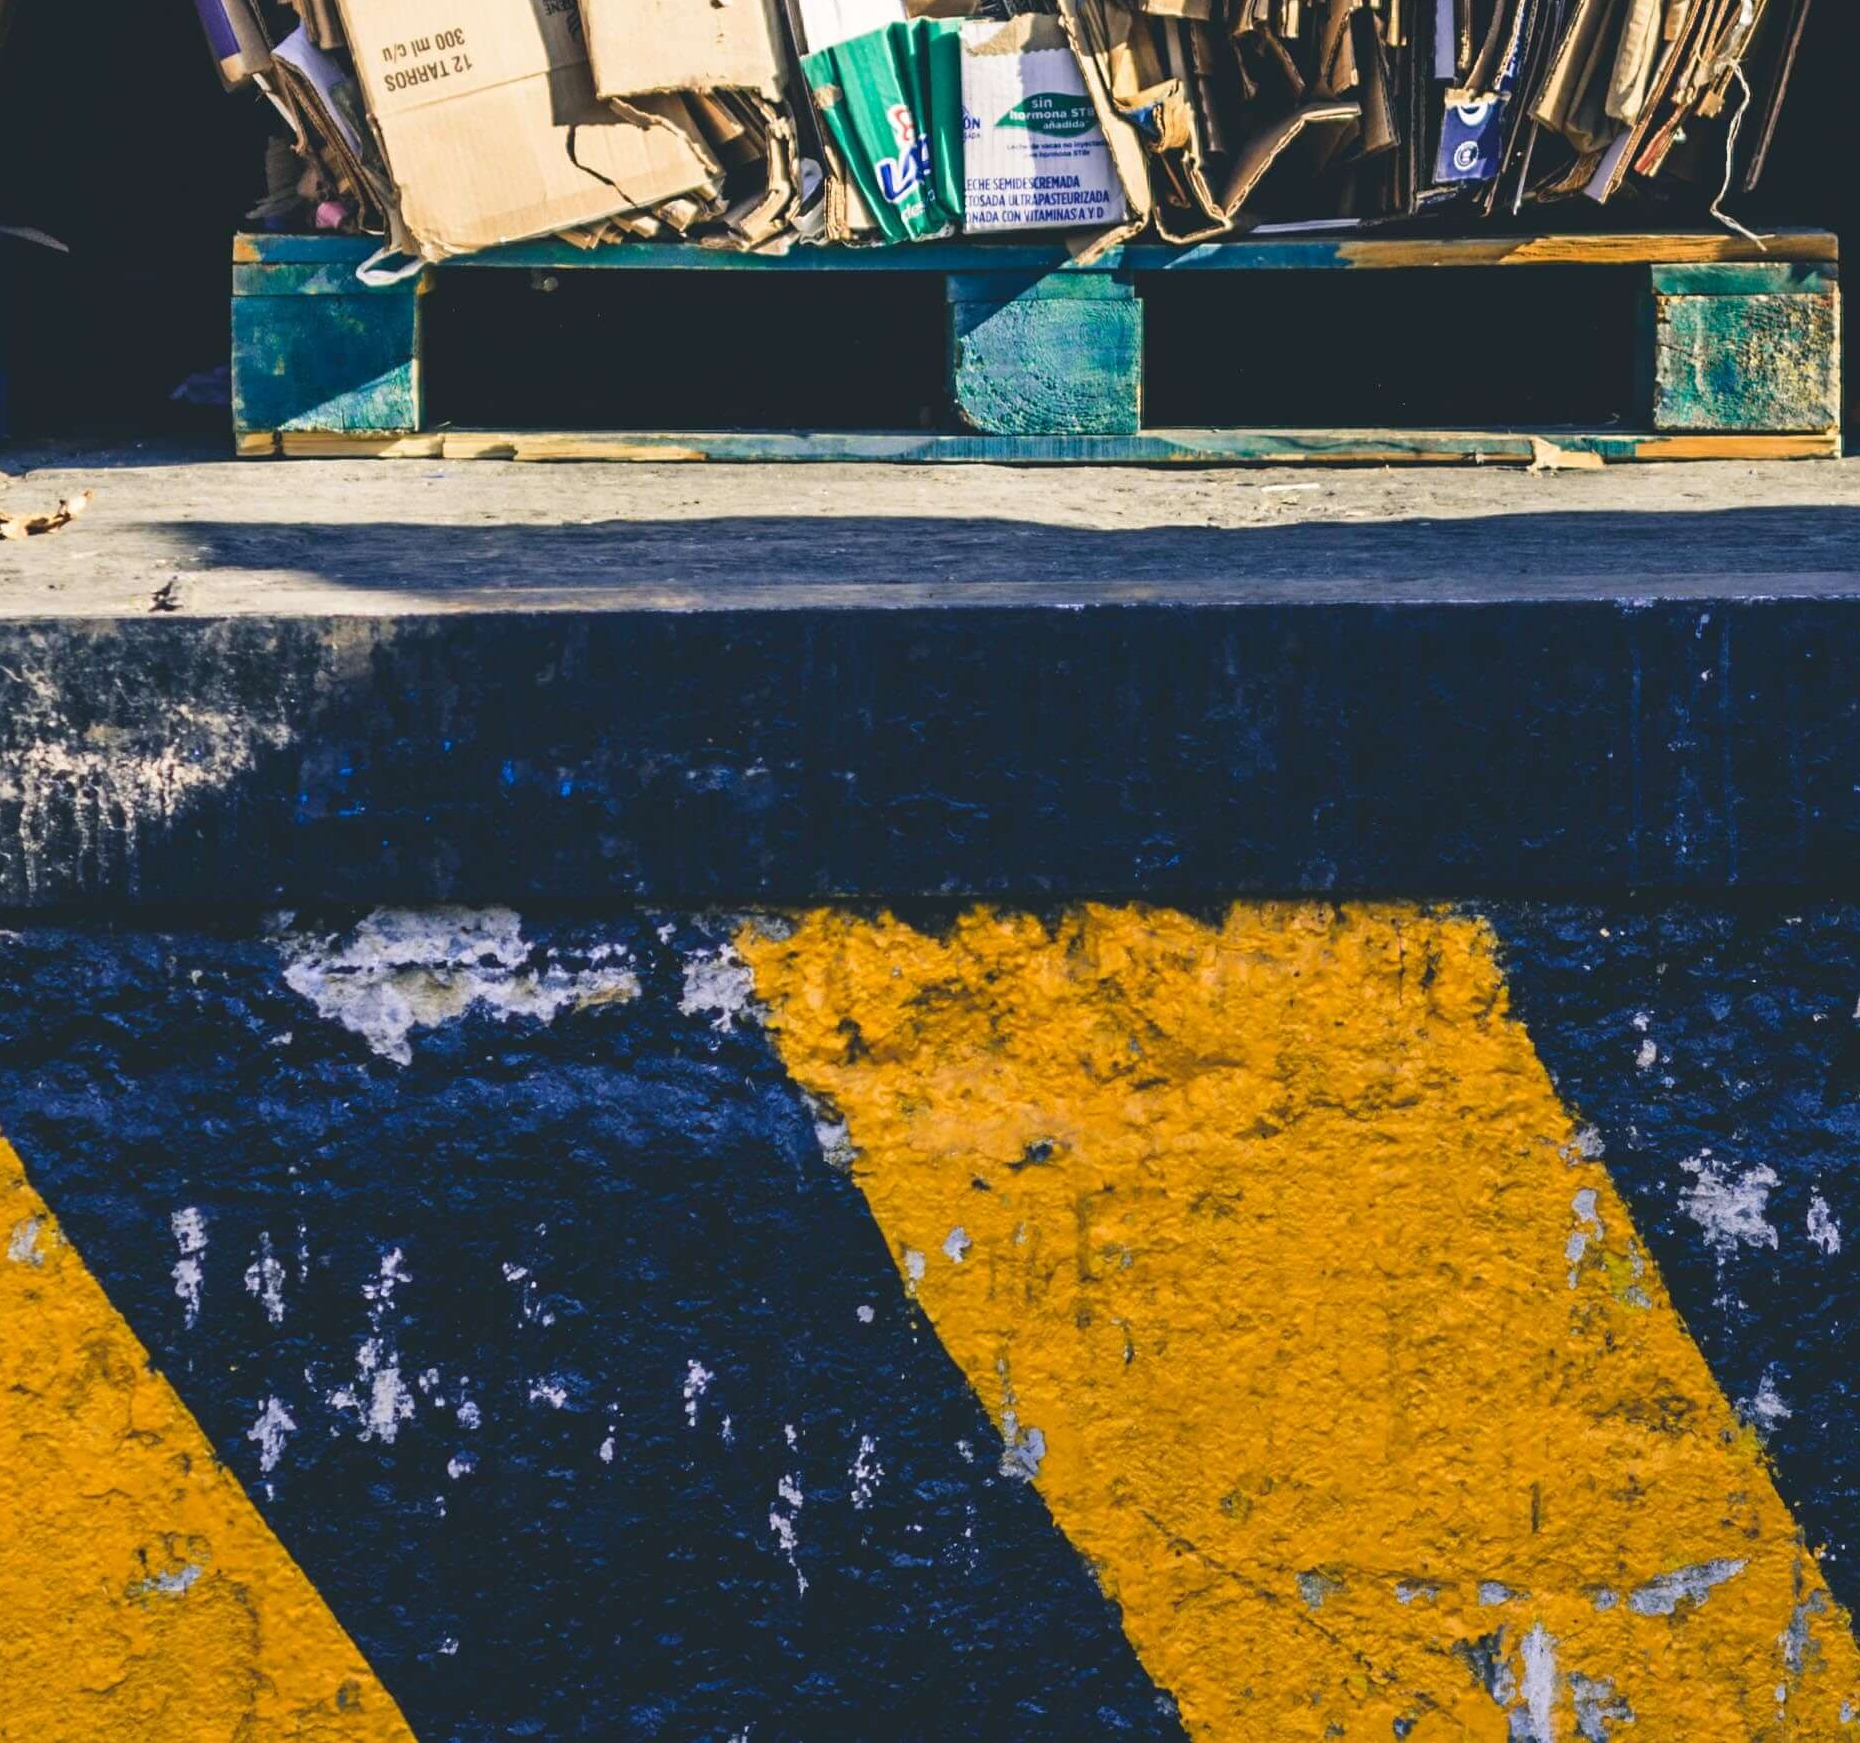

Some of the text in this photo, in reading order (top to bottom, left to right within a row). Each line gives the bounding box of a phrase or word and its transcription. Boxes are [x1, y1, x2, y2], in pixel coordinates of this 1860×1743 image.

[382, 27, 466, 63] 300 ml c/u
[384, 52, 474, 93] 12 TARROS
[1031, 97, 1053, 109] sin
[1009, 108, 1068, 121] hormona
[1042, 120, 1086, 131] añadida
[965, 175, 1080, 192] ECHE SEMIDESCREMADA
[1008, 190, 1110, 207] ULTRAPASTEURIZADA
[1001, 210, 1023, 222] CON
[1024, 208, 1076, 221] VITAMINAS
[1076, 208, 1086, 219] A
[1086, 207, 1095, 218] Y
[1096, 207, 1104, 218] D
